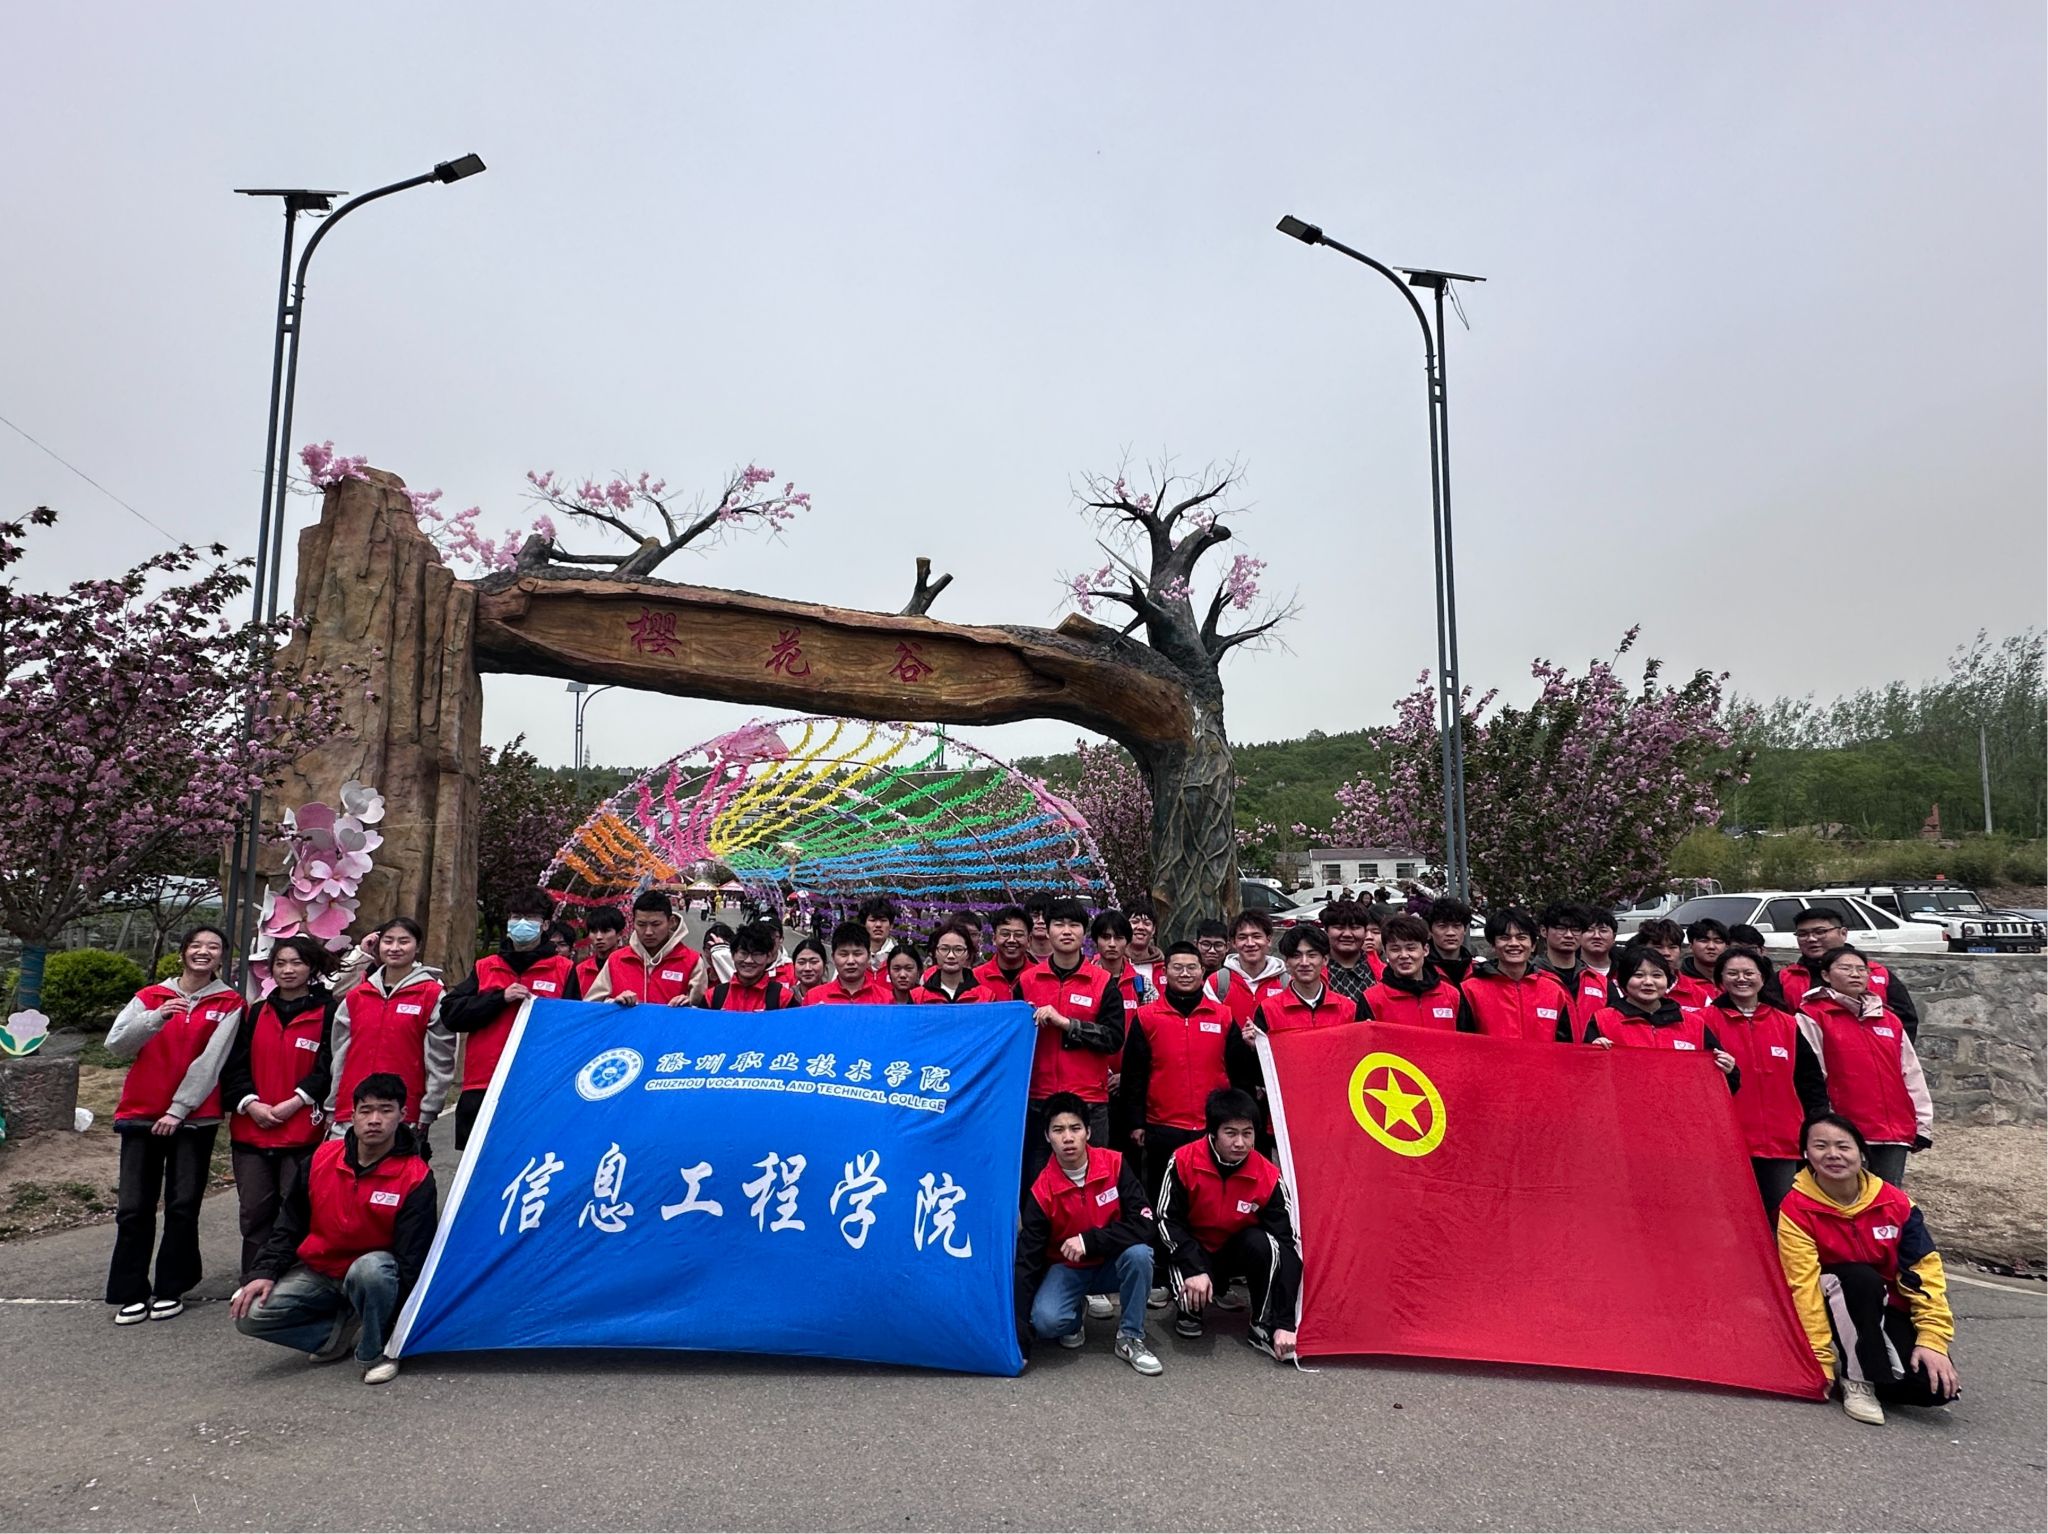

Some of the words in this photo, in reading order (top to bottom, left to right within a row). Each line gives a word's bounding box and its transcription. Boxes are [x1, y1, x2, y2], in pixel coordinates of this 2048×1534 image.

[626, 606, 935, 682] 樱花谷
[645, 1078, 705, 1091] CHUZHOU
[706, 1077, 785, 1091] VOCATIONAL
[786, 1080, 815, 1092] AND
[817, 1082, 887, 1103] TECHNICAL
[889, 1094, 947, 1113] COLLEGE
[656, 1051, 950, 1091] 滁州职业技术学院
[500, 1142, 973, 1258] 信息工程学院
